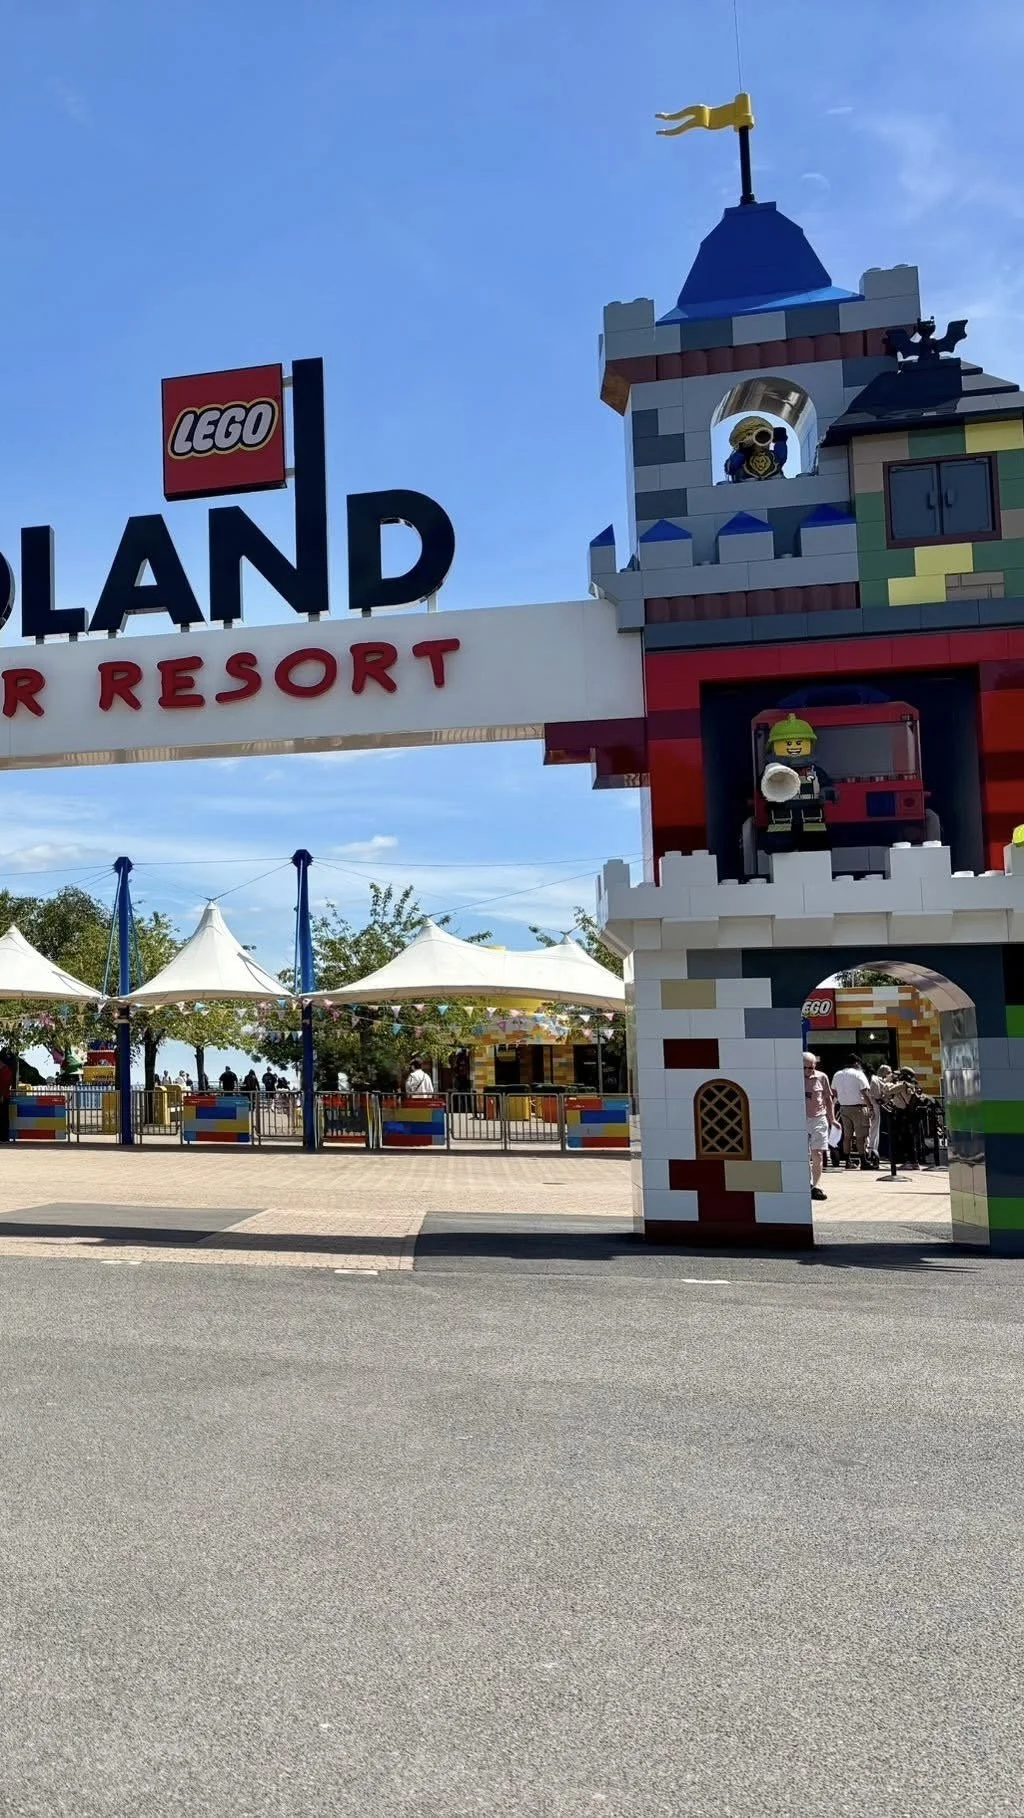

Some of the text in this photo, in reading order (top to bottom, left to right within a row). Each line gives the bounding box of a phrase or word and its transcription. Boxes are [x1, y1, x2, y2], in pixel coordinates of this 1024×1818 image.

[170, 399, 276, 457] LEGO
[98, 637, 461, 712] RESORT
[802, 999, 832, 1016] EGO
